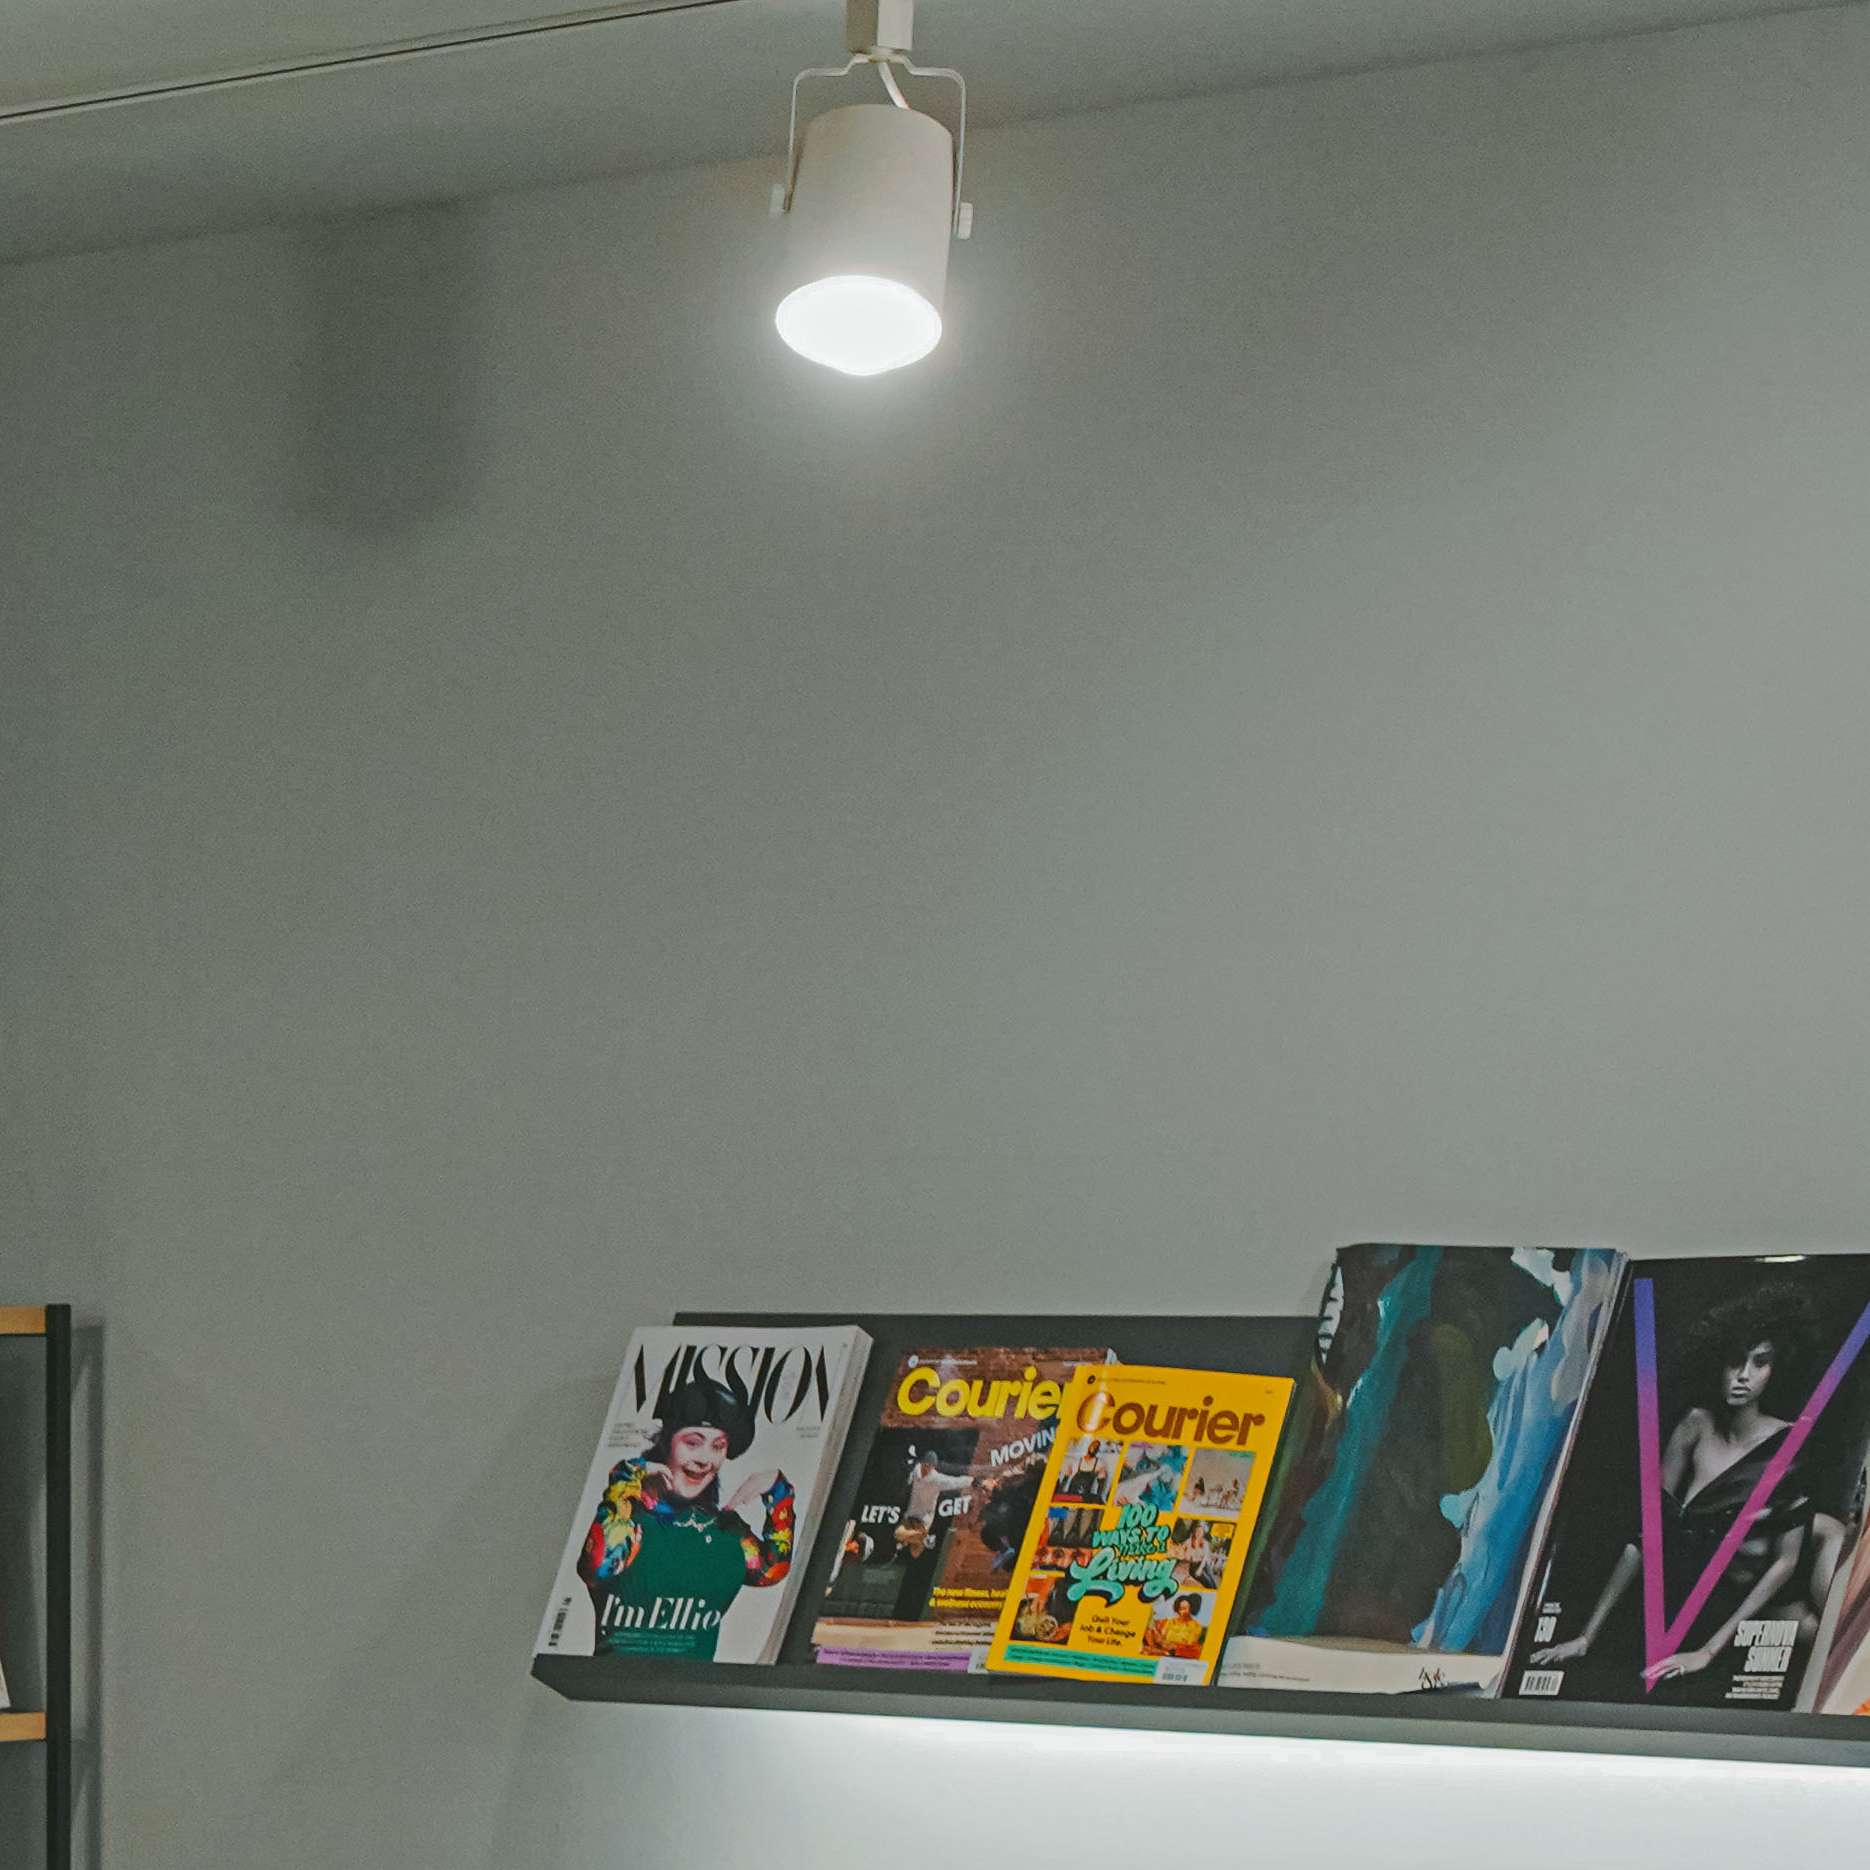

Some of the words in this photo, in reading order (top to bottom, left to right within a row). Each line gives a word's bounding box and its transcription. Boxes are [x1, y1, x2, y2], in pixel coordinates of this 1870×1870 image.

[634, 1343, 830, 1426] MISSION
[1077, 1390, 1266, 1447] Courier
[862, 1503, 901, 1524] LET'S
[939, 1495, 970, 1518] GET
[990, 1426, 1058, 1468] MOVIN
[1117, 1503, 1157, 1528] 100
[1067, 1546, 1178, 1603] Living
